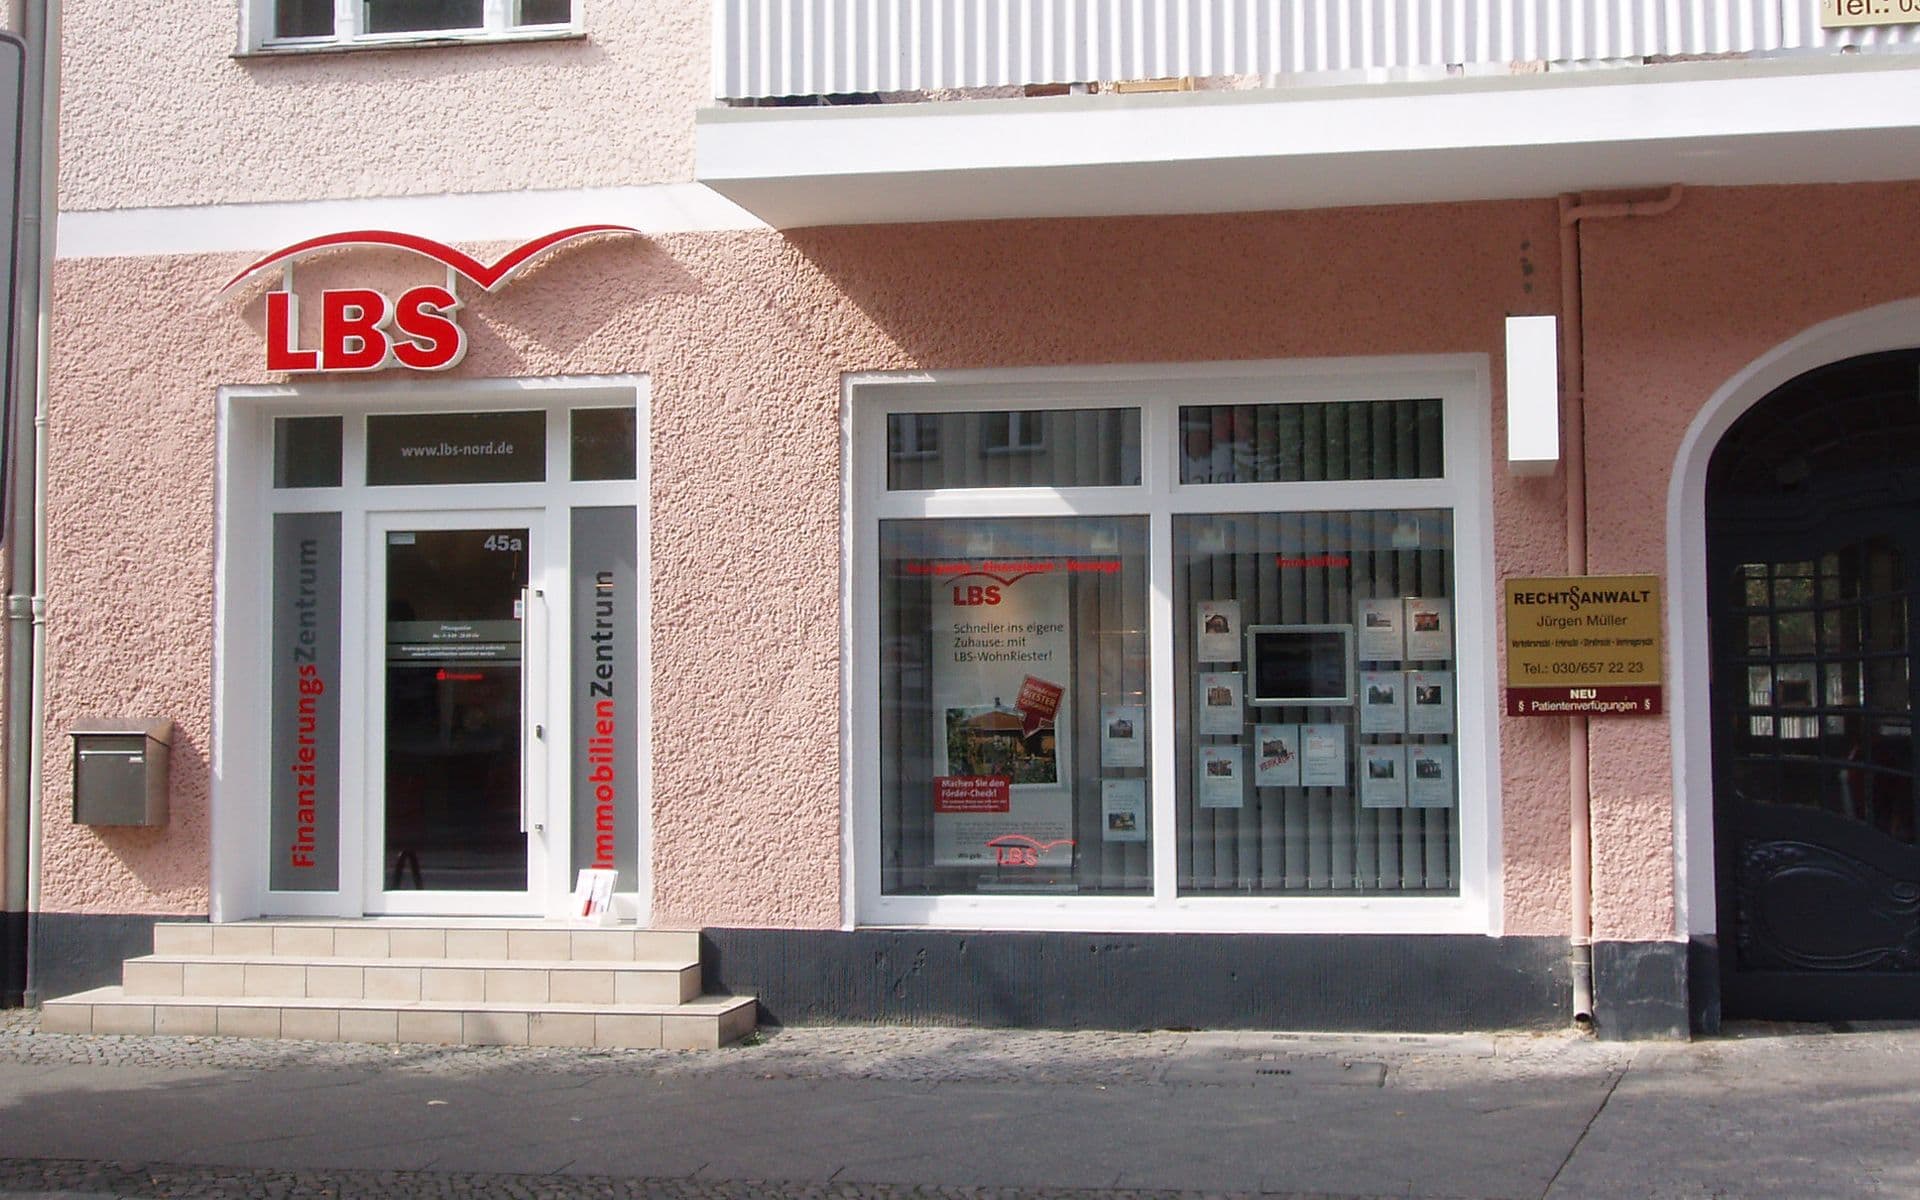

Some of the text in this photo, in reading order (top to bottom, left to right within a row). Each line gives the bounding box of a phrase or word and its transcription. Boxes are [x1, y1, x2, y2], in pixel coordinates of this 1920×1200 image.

[265, 285, 465, 372] LBS
[400, 440, 515, 458] www.lbs-nord.de
[483, 534, 523, 552] 45a
[952, 585, 1003, 606] LBS
[953, 622, 1064, 636] Schneller ins eigene
[1536, 614, 1628, 630] Jürgen Müller
[1007, 637, 1026, 648] mit
[1523, 661, 1644, 675] Tel.: 030/657 22 23
[1570, 688, 1597, 700] NEU
[291, 538, 324, 868] FinanzierungsZentrum
[1531, 700, 1638, 713] Patientenverfügungen
[997, 847, 1038, 867] LBS
